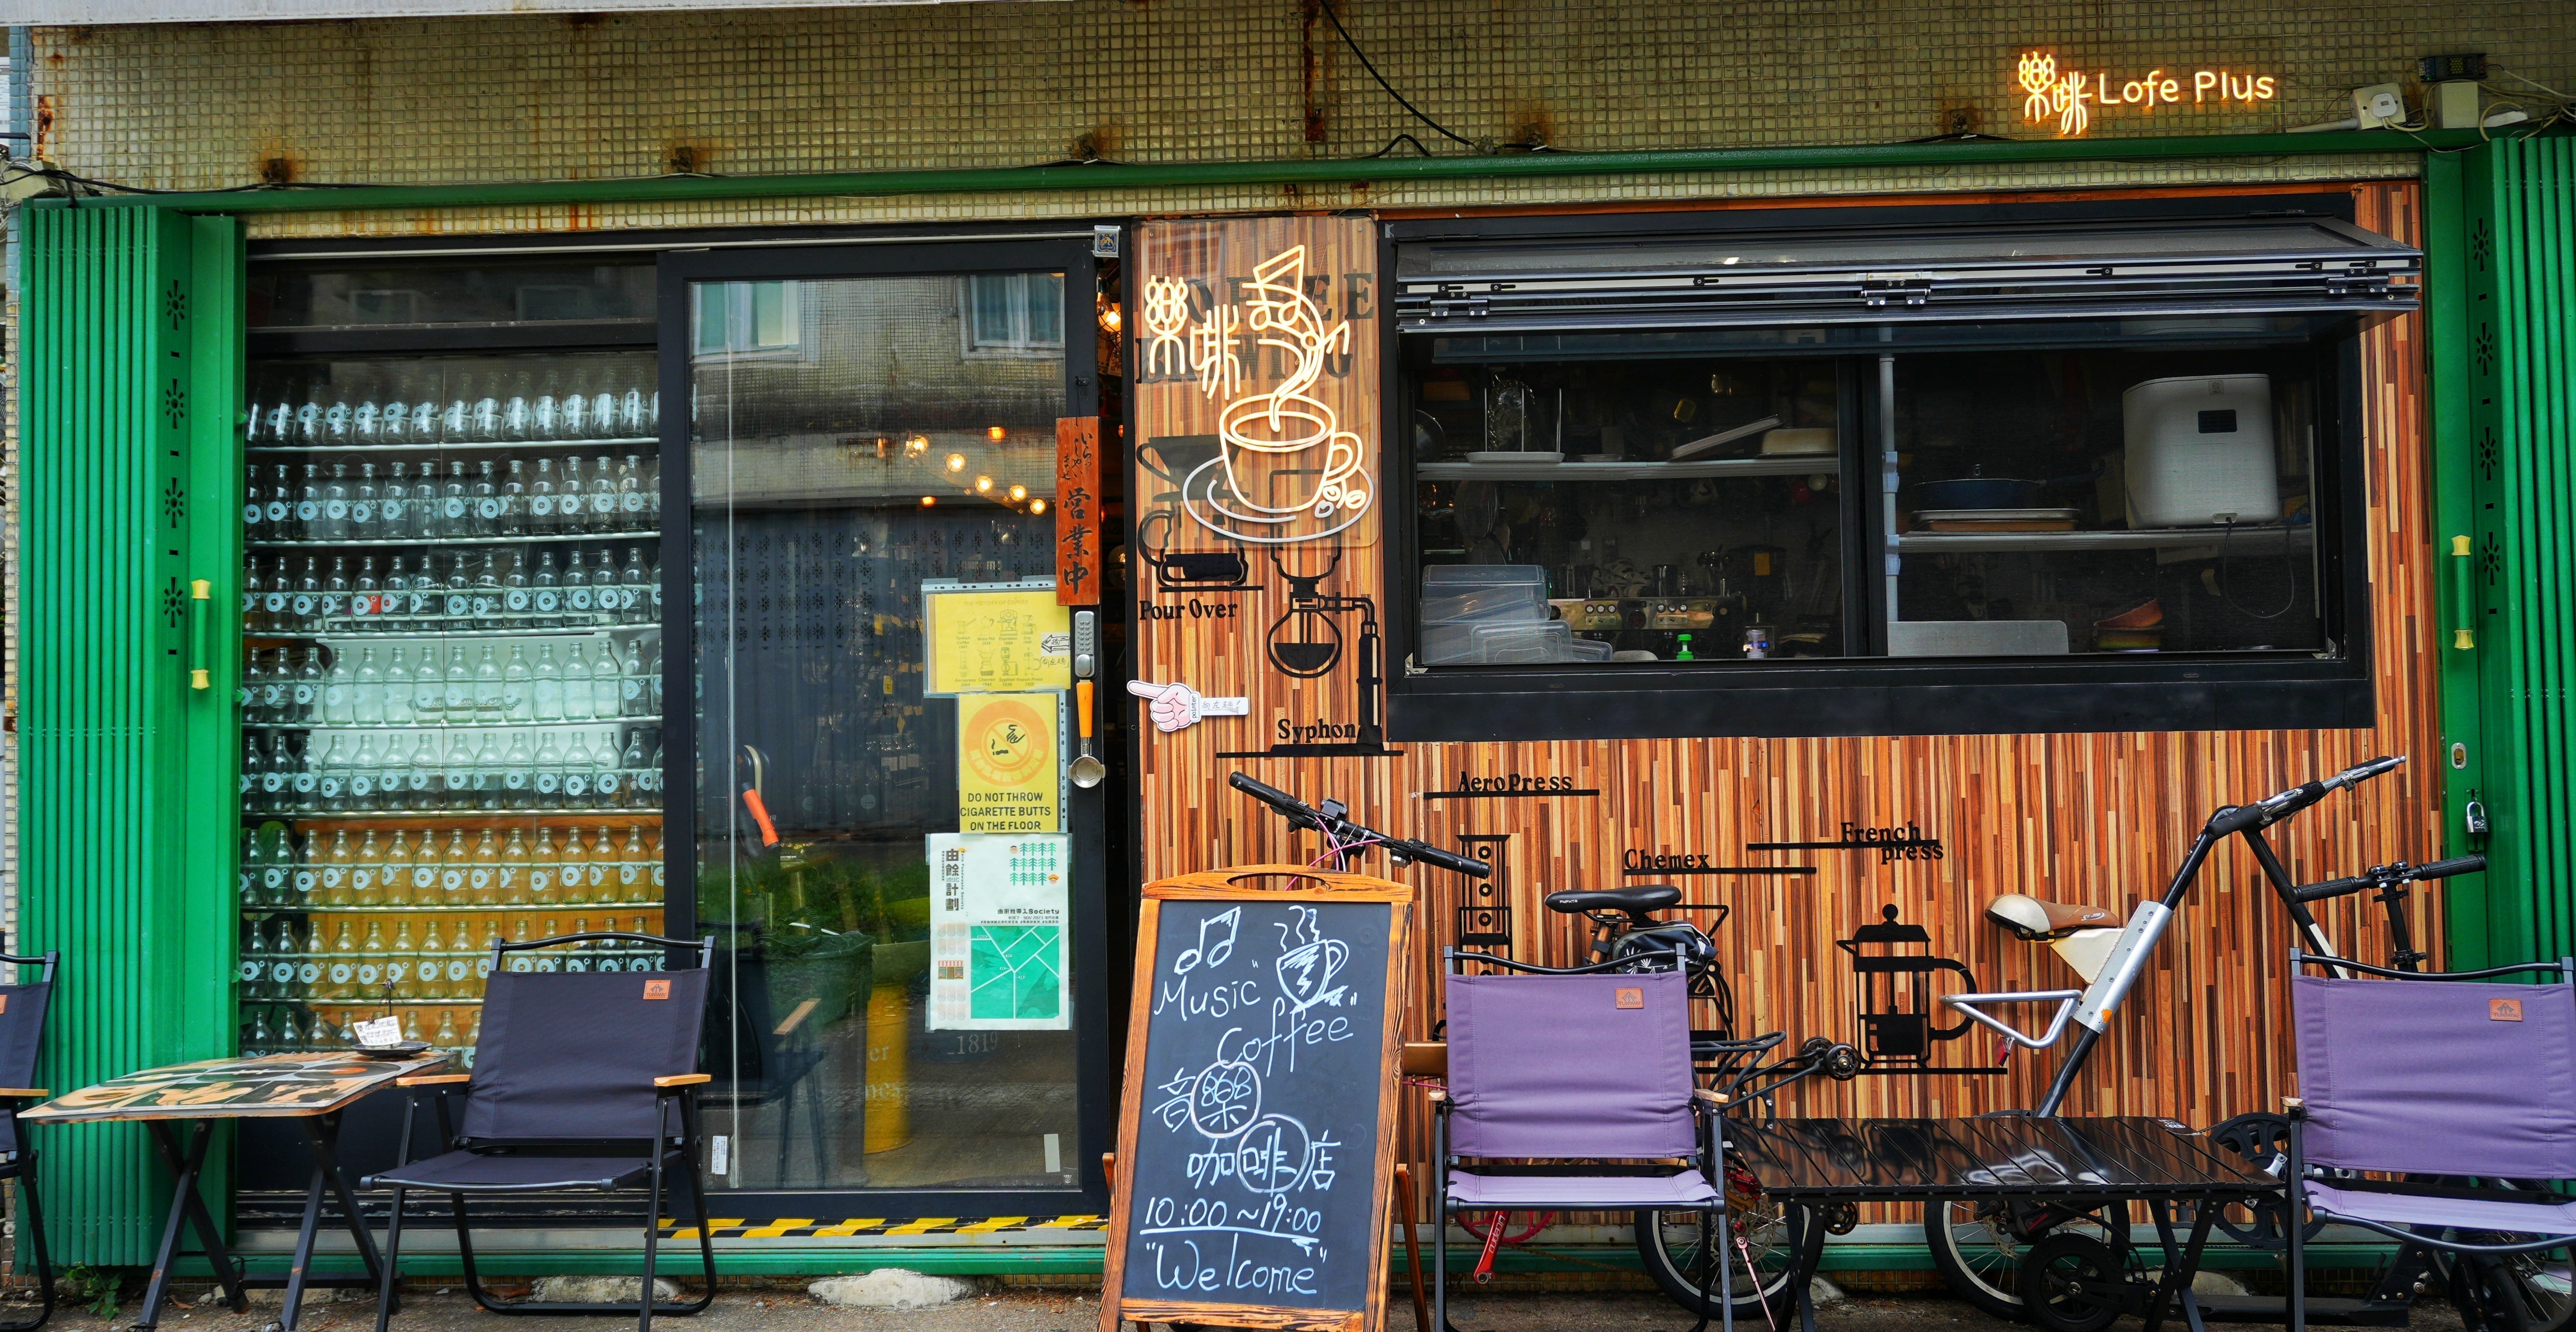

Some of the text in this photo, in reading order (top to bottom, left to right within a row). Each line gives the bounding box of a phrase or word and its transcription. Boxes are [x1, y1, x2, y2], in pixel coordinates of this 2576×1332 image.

[2099, 70, 2179, 107] Lofe
[2194, 70, 2274, 104] Plus
[1139, 598, 1238, 620] Pour Over
[1278, 719, 1356, 743] Syphon
[968, 792, 1043, 802] DO NOT THROW
[960, 807, 1050, 817] CIGARETTE BUTTS
[970, 821, 1041, 830] ON THE FLOOR
[1841, 820, 1921, 842] French
[1624, 849, 1710, 870] Chemex
[1881, 845, 1943, 865] press
[1154, 975, 1260, 1021] Music
[1217, 997, 1353, 1077] Coffee
[1187, 1126, 1341, 1196] 咖啡店
